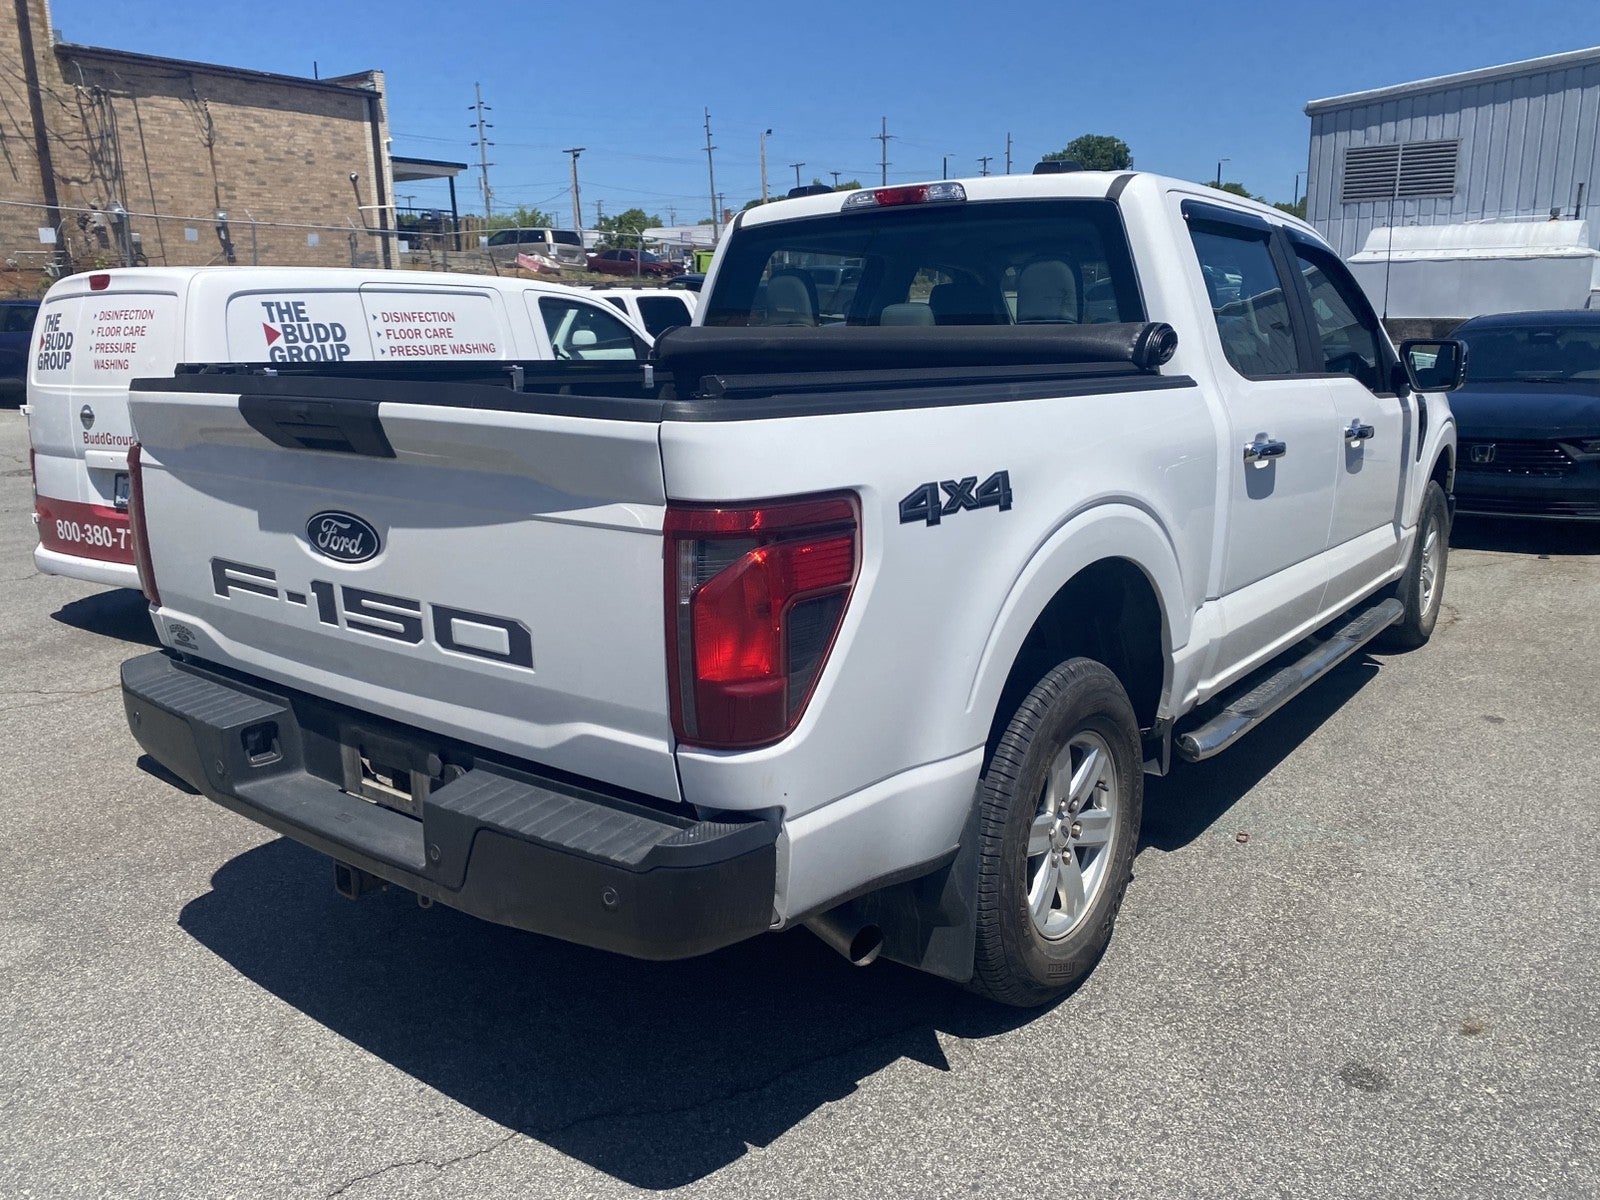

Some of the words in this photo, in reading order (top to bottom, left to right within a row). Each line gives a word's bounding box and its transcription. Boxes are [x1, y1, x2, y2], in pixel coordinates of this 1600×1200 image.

[99, 310, 155, 321] DISINFECTION
[261, 301, 309, 323] THE
[381, 312, 456, 323] DISINFECTION
[44, 313, 62, 333] THE
[97, 326, 121, 337] FLOOR
[123, 326, 147, 337] CARE
[45, 332, 74, 351] BUDD
[281, 323, 347, 344] BUDD
[386, 328, 422, 340] FLOOR
[425, 328, 454, 339] CARE
[95, 343, 136, 354] PRESSURE
[269, 344, 350, 362] GROUP
[390, 345, 448, 356] PRESSURE
[449, 343, 496, 354] WASHING
[37, 352, 72, 370] GROUP
[94, 360, 129, 370] WASHING
[317, 518, 363, 555] Ford
[209, 556, 535, 673] F-150
